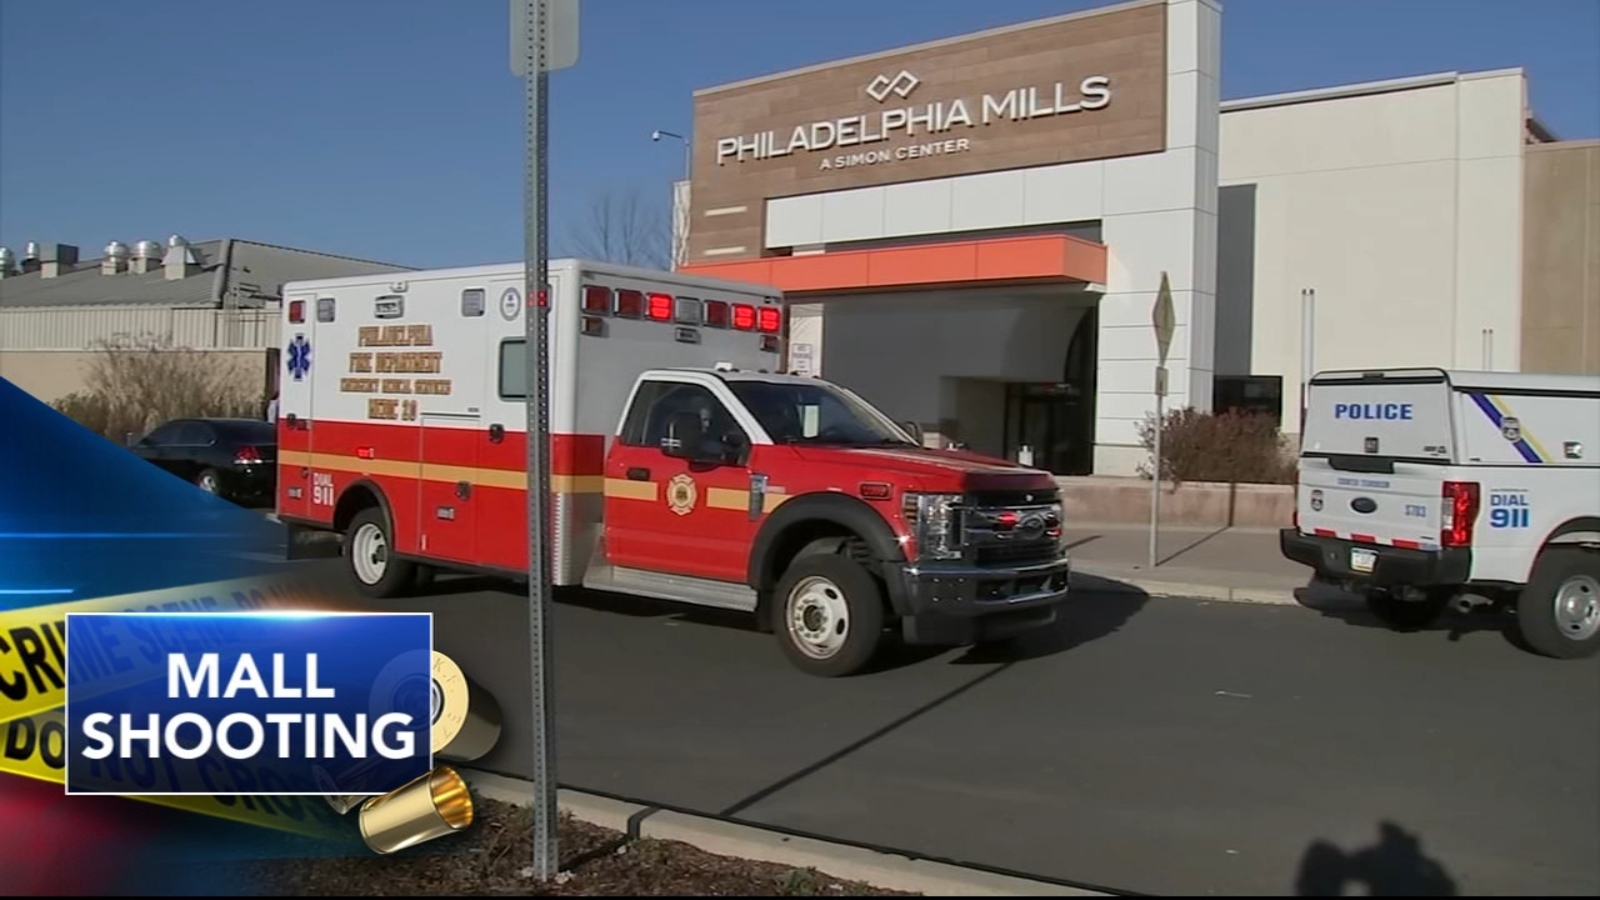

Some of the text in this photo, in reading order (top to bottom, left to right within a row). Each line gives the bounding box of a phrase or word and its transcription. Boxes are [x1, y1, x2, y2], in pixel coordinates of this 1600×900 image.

[717, 76, 1111, 165] PHILADELPHIA MILLS
[819, 138, 970, 170] A SIMON CENTER
[1334, 403, 1413, 421] POLICE
[313, 472, 334, 487] DIAL
[313, 486, 334, 506] 911
[1490, 494, 1529, 506] DIAL
[1490, 508, 1529, 527] 911
